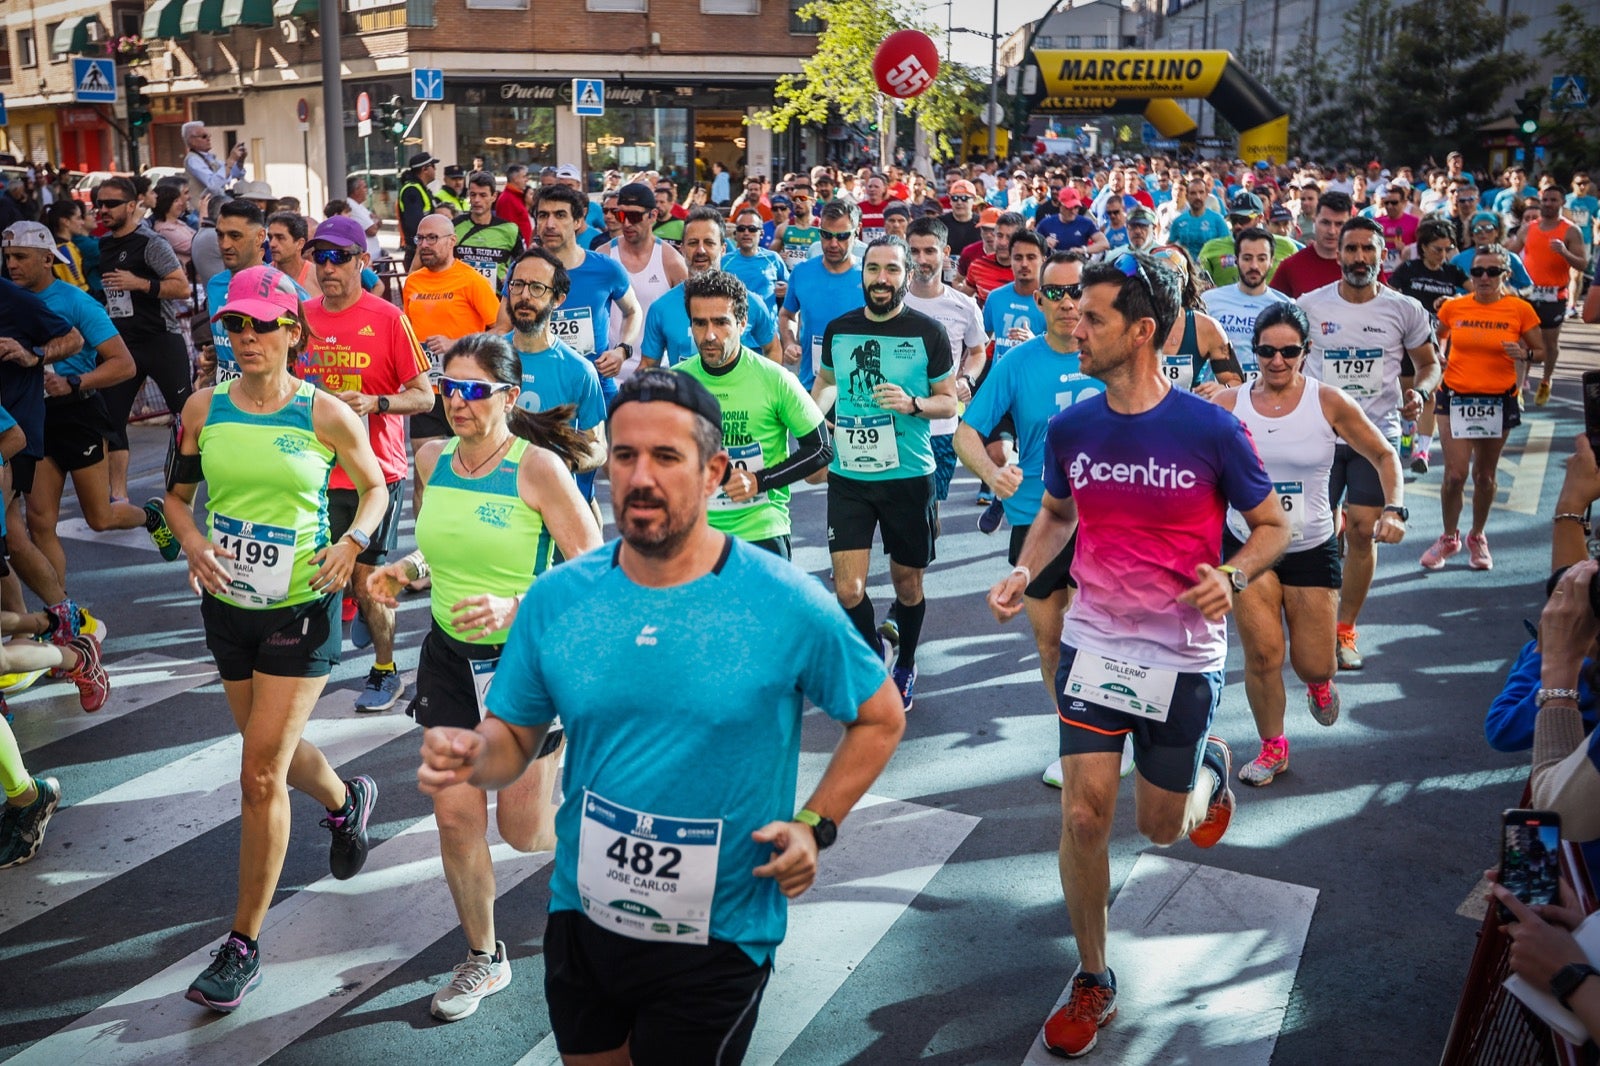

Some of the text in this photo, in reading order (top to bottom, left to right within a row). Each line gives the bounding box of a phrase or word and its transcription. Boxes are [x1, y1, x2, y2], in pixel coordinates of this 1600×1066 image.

[1058, 59, 1203, 81] MARCELINO
[500, 83, 555, 99] Puerta
[476, 248, 502, 257] RURAL
[1461, 320, 1509, 329] MARCELINO
[297, 351, 371, 369] MADRID
[1333, 360, 1375, 374] 1797
[325, 374, 340, 385] 42
[1459, 406, 1495, 418] 1054
[846, 428, 879, 444] 739
[220, 534, 279, 567] 1199
[233, 562, 254, 573] MARÍA
[1104, 662, 1147, 679] GUILLERMO
[606, 836, 682, 879] 482
[606, 869, 631, 884] JOSE
[633, 877, 677, 893] CARLOS
